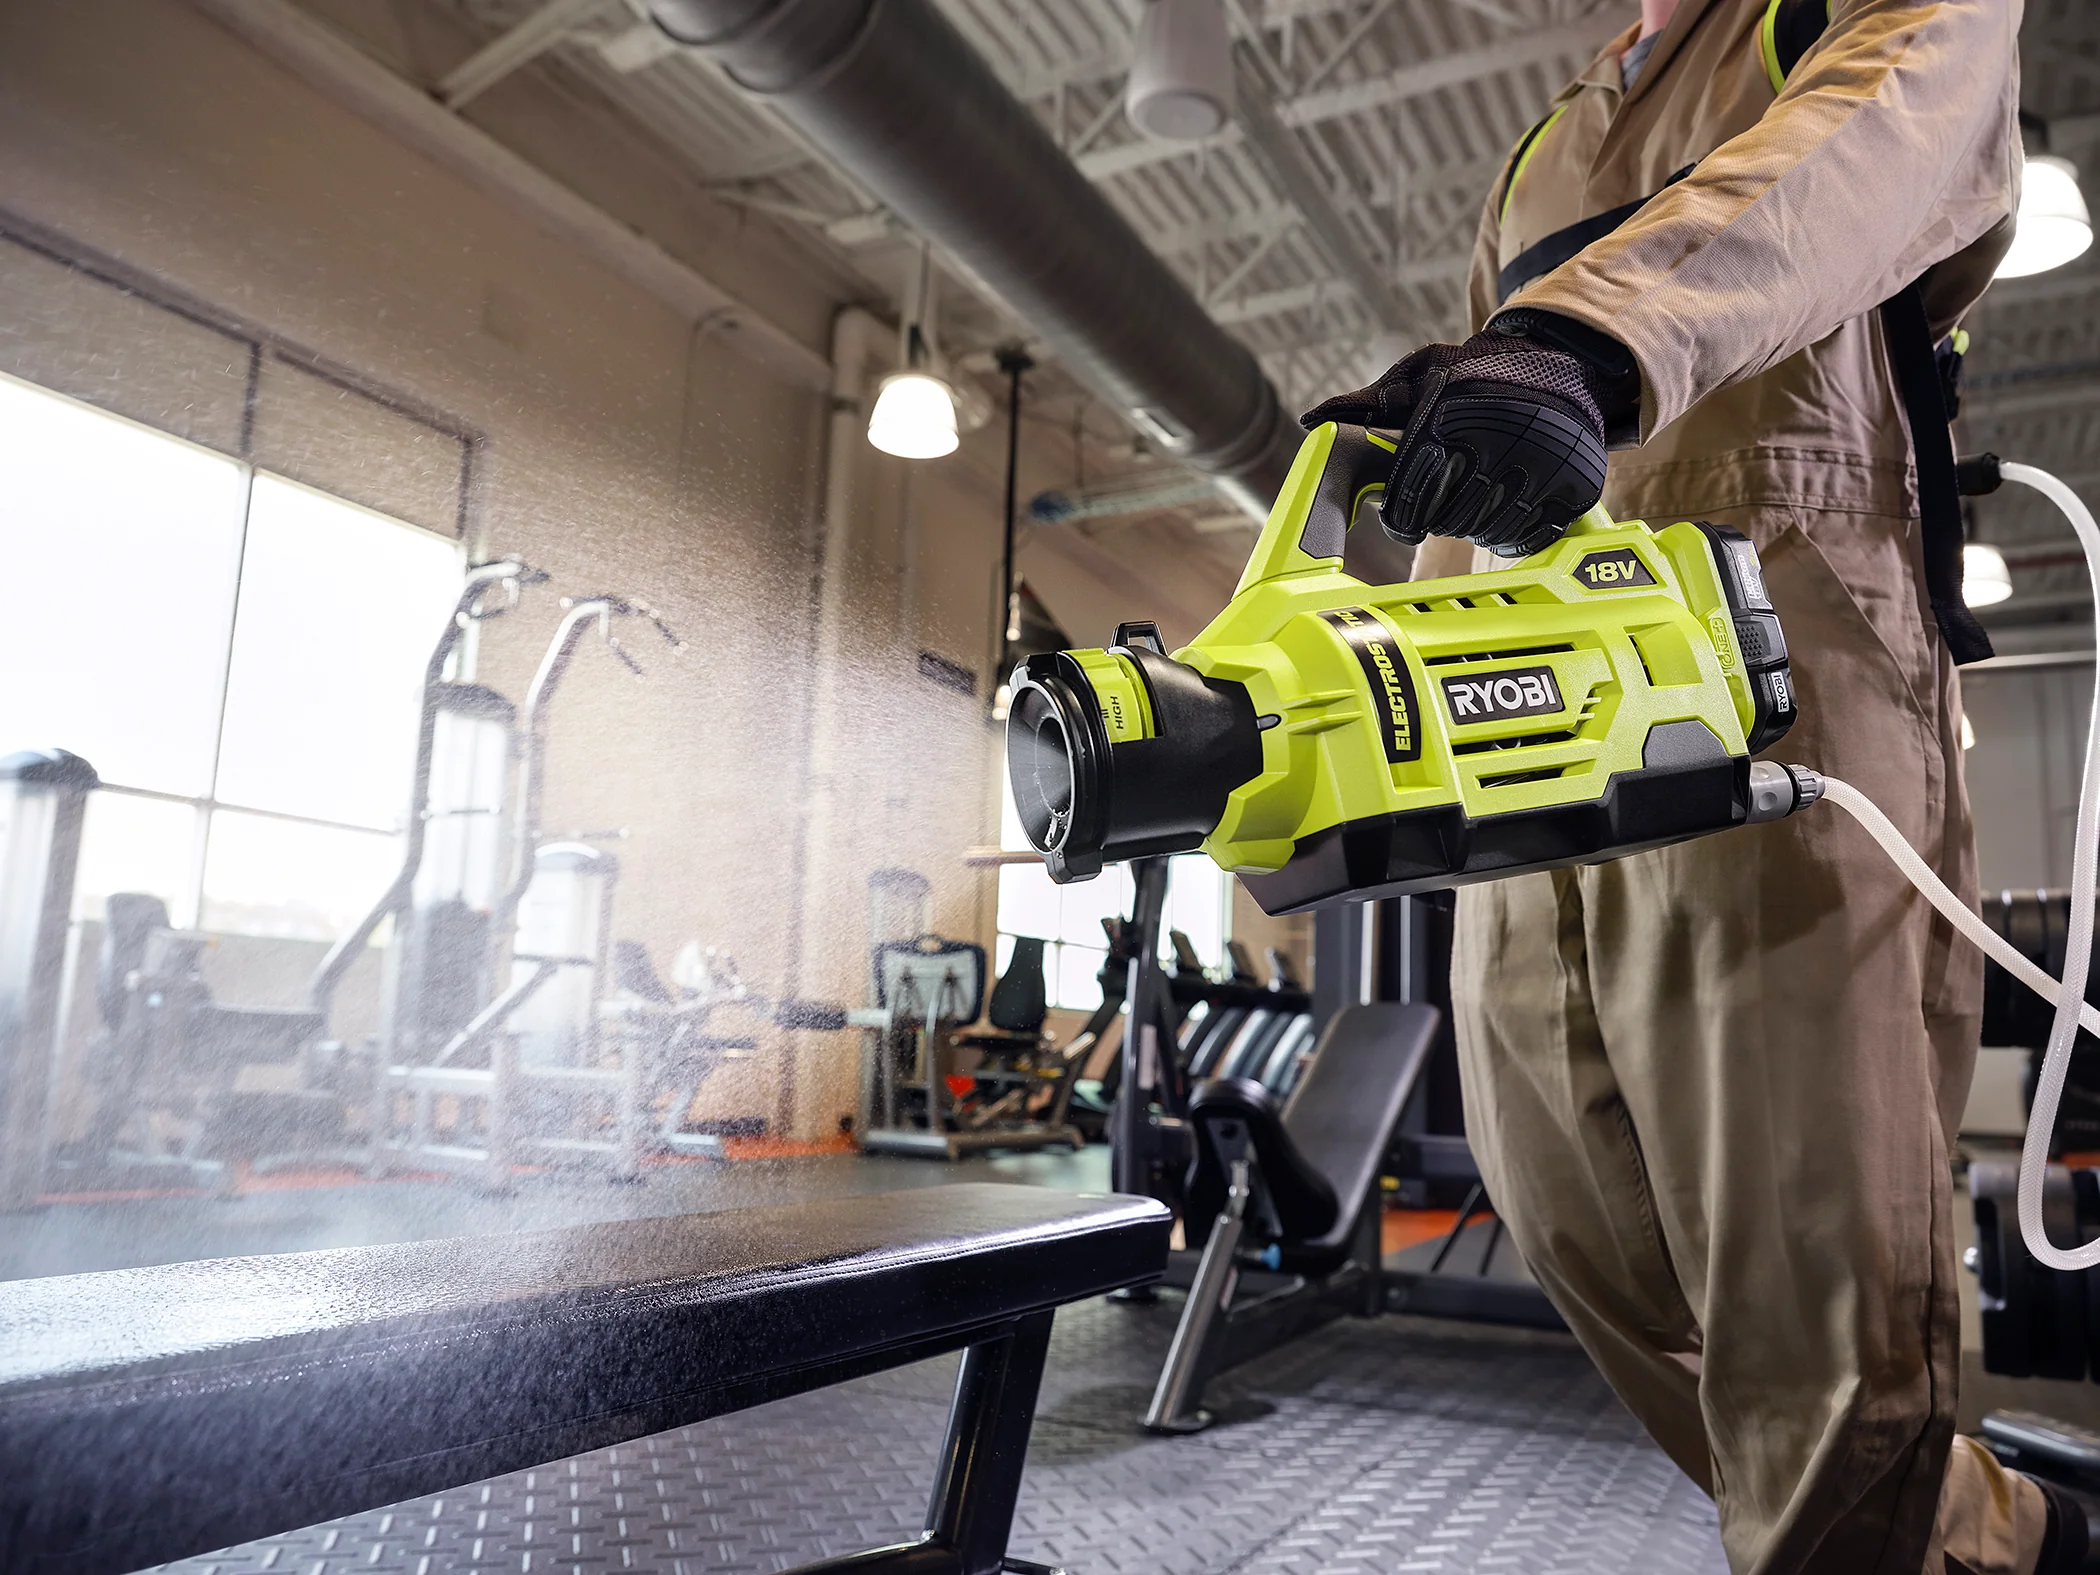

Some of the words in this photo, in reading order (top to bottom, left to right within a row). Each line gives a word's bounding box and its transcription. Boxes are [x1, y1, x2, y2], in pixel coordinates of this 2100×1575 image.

[1585, 560, 1637, 583] 18V
[1334, 611, 1411, 751] ELECTROSTTIC
[1447, 674, 1556, 717] RYOBI
[1774, 675, 1787, 710] RYOBI
[1110, 696, 1124, 730] HIGH
